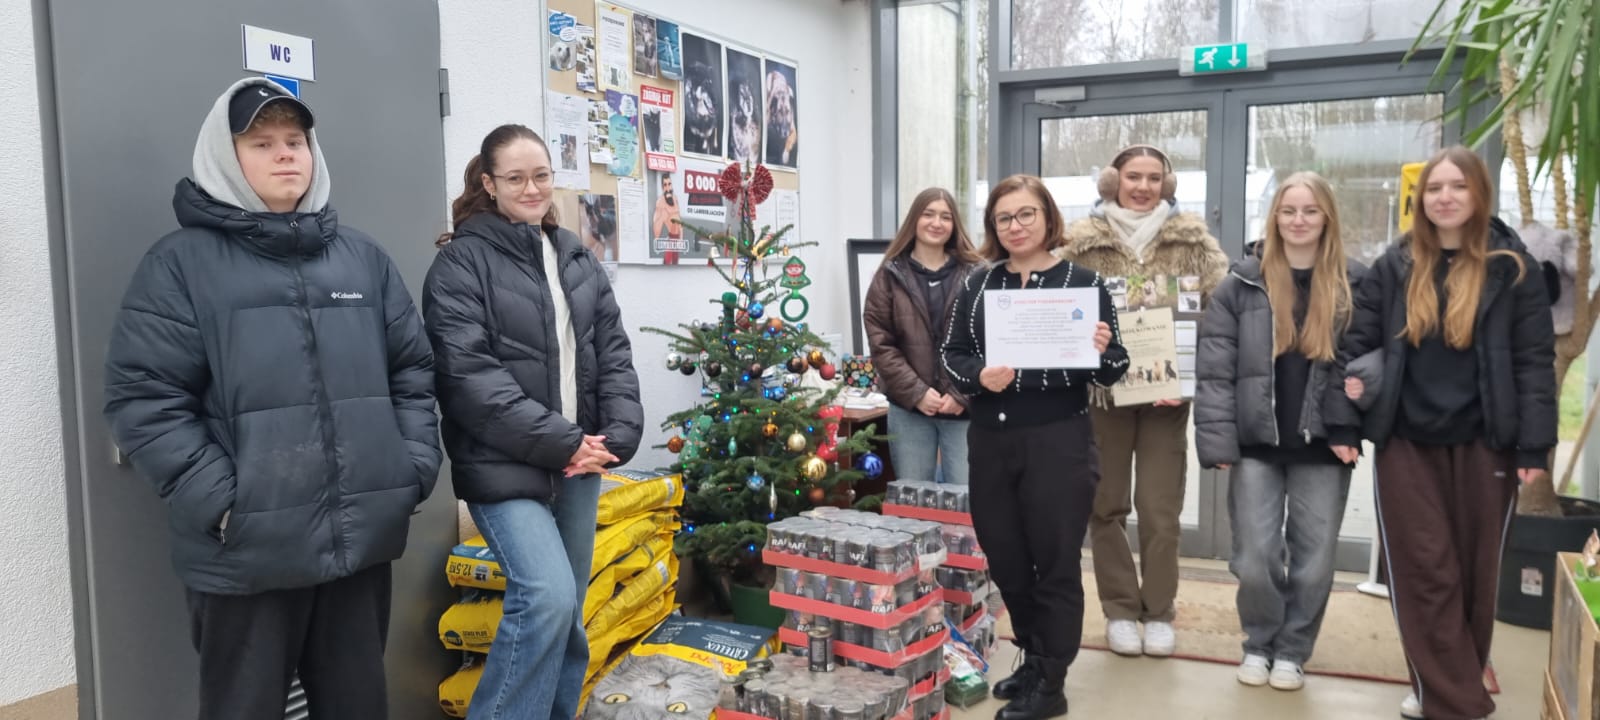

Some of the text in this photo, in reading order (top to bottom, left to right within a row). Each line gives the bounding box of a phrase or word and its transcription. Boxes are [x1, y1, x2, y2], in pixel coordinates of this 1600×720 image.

[270, 43, 291, 63] WC
[695, 175, 716, 191] 000
[337, 291, 363, 299] Columbia
